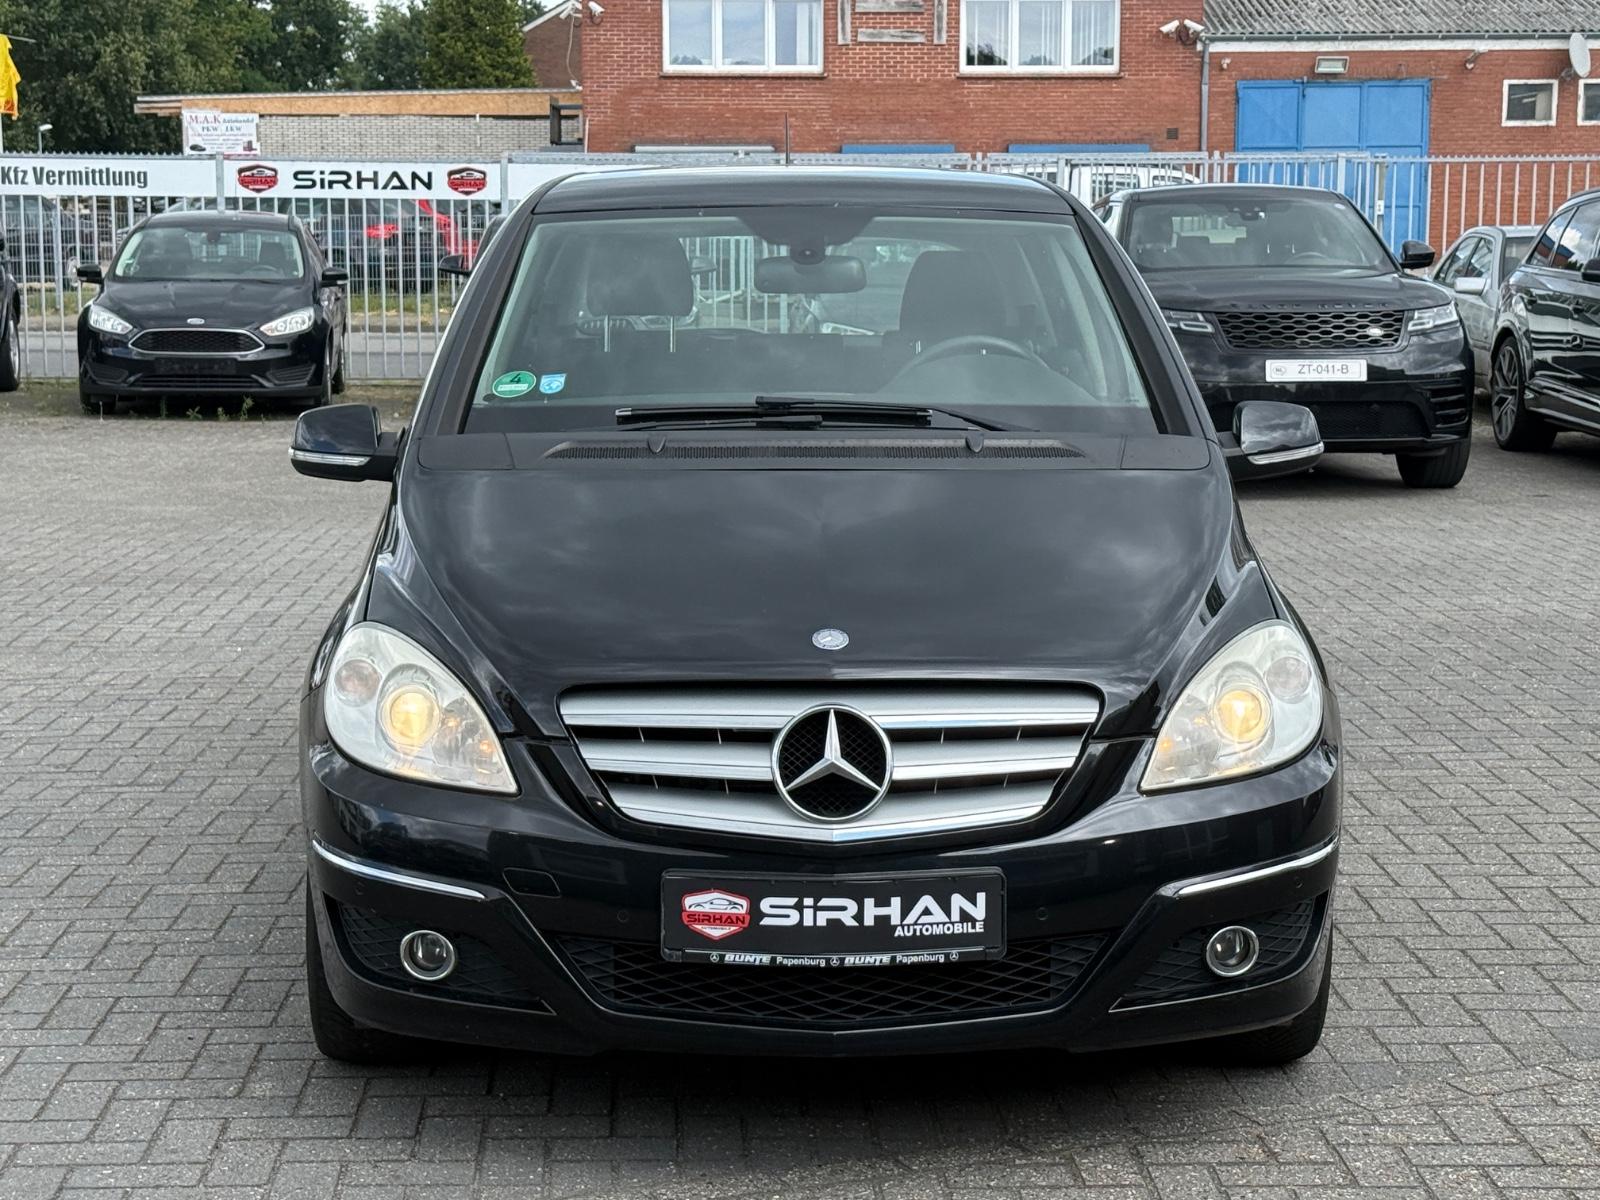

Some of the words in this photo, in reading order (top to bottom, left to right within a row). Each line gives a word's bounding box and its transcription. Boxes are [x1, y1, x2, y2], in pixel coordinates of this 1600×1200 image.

[0, 166, 29, 186] Kfz
[33, 166, 148, 189] Vermittlung
[1297, 363, 1350, 375] ZT-041-B
[510, 373, 522, 384] 4
[894, 922, 985, 937] AUTOMOBILE
[724, 954, 772, 965] BUNTE
[776, 956, 826, 968] Papenburg
[844, 955, 891, 966] BUNTE
[896, 953, 945, 964] Papenburg
